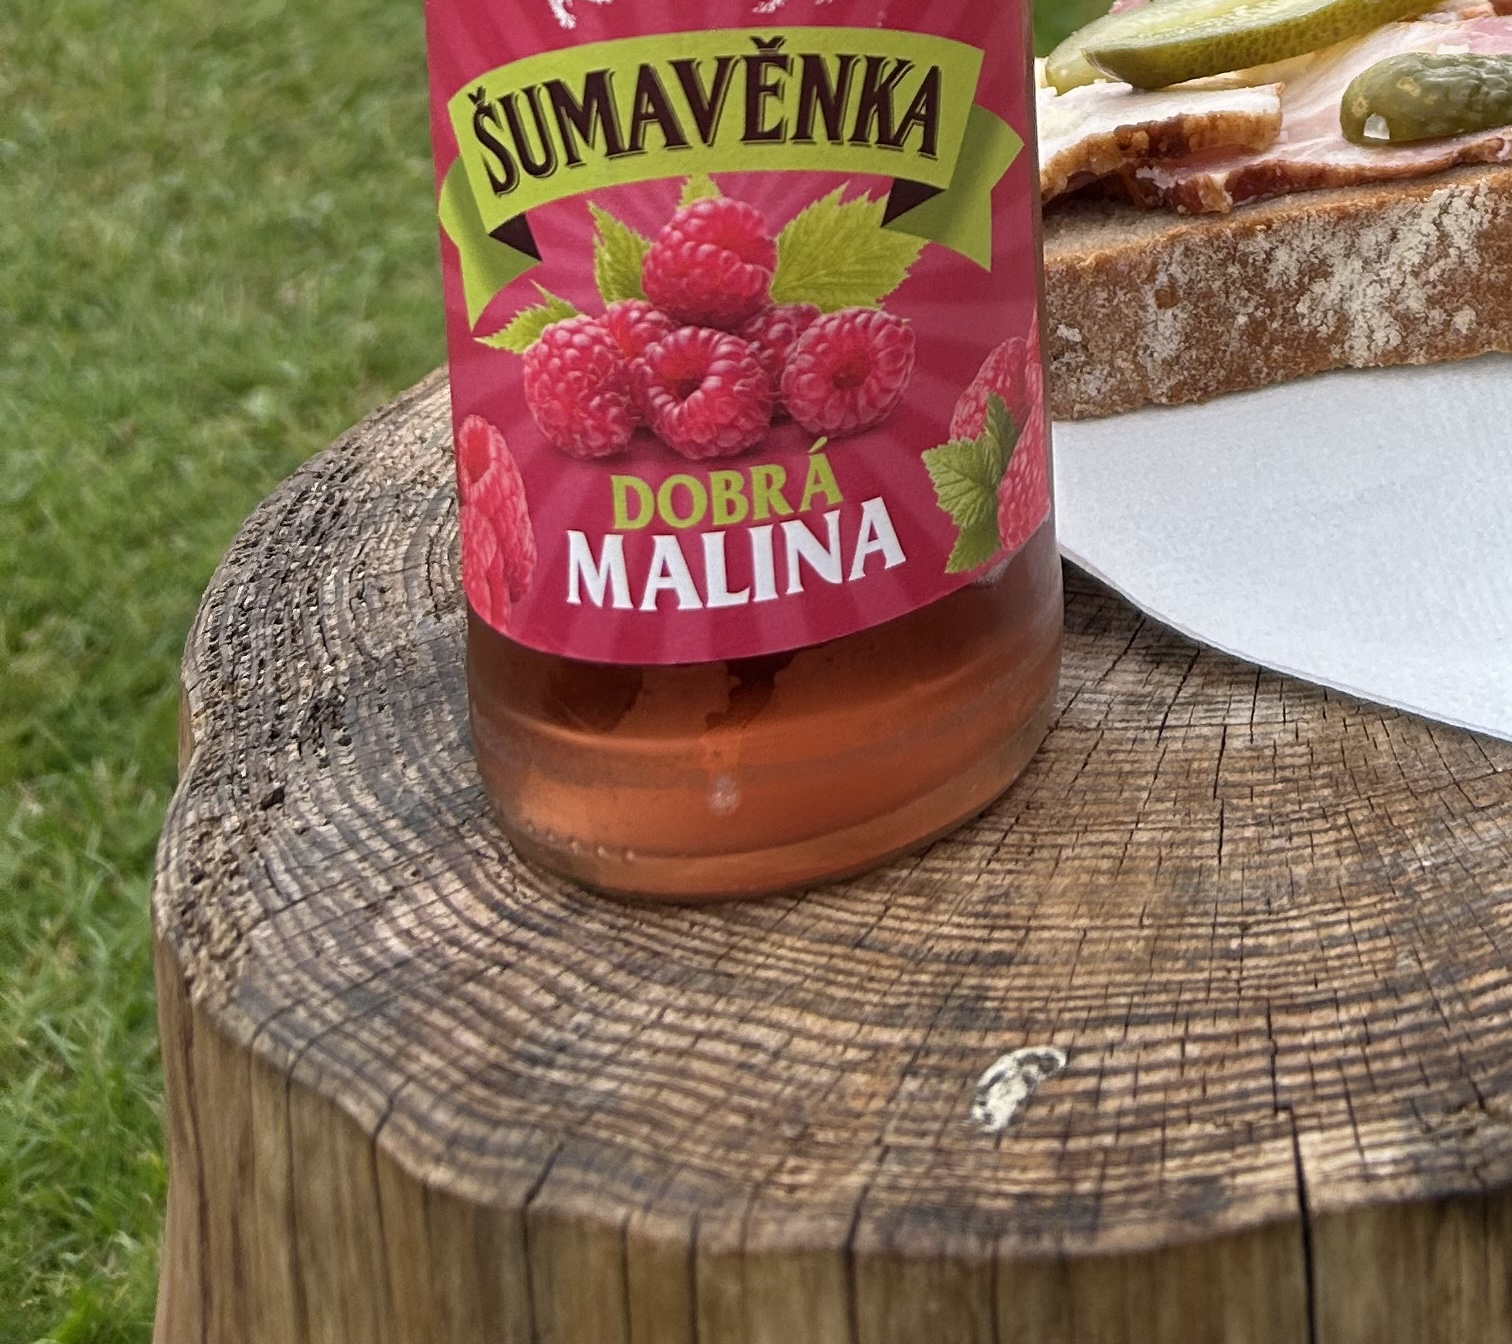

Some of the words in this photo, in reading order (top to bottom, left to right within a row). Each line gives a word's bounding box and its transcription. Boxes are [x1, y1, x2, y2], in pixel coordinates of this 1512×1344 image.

[467, 35, 940, 196] ŠUMAVĚNKA
[610, 435, 844, 531] DOBRÁ
[565, 495, 907, 612] MALINA
